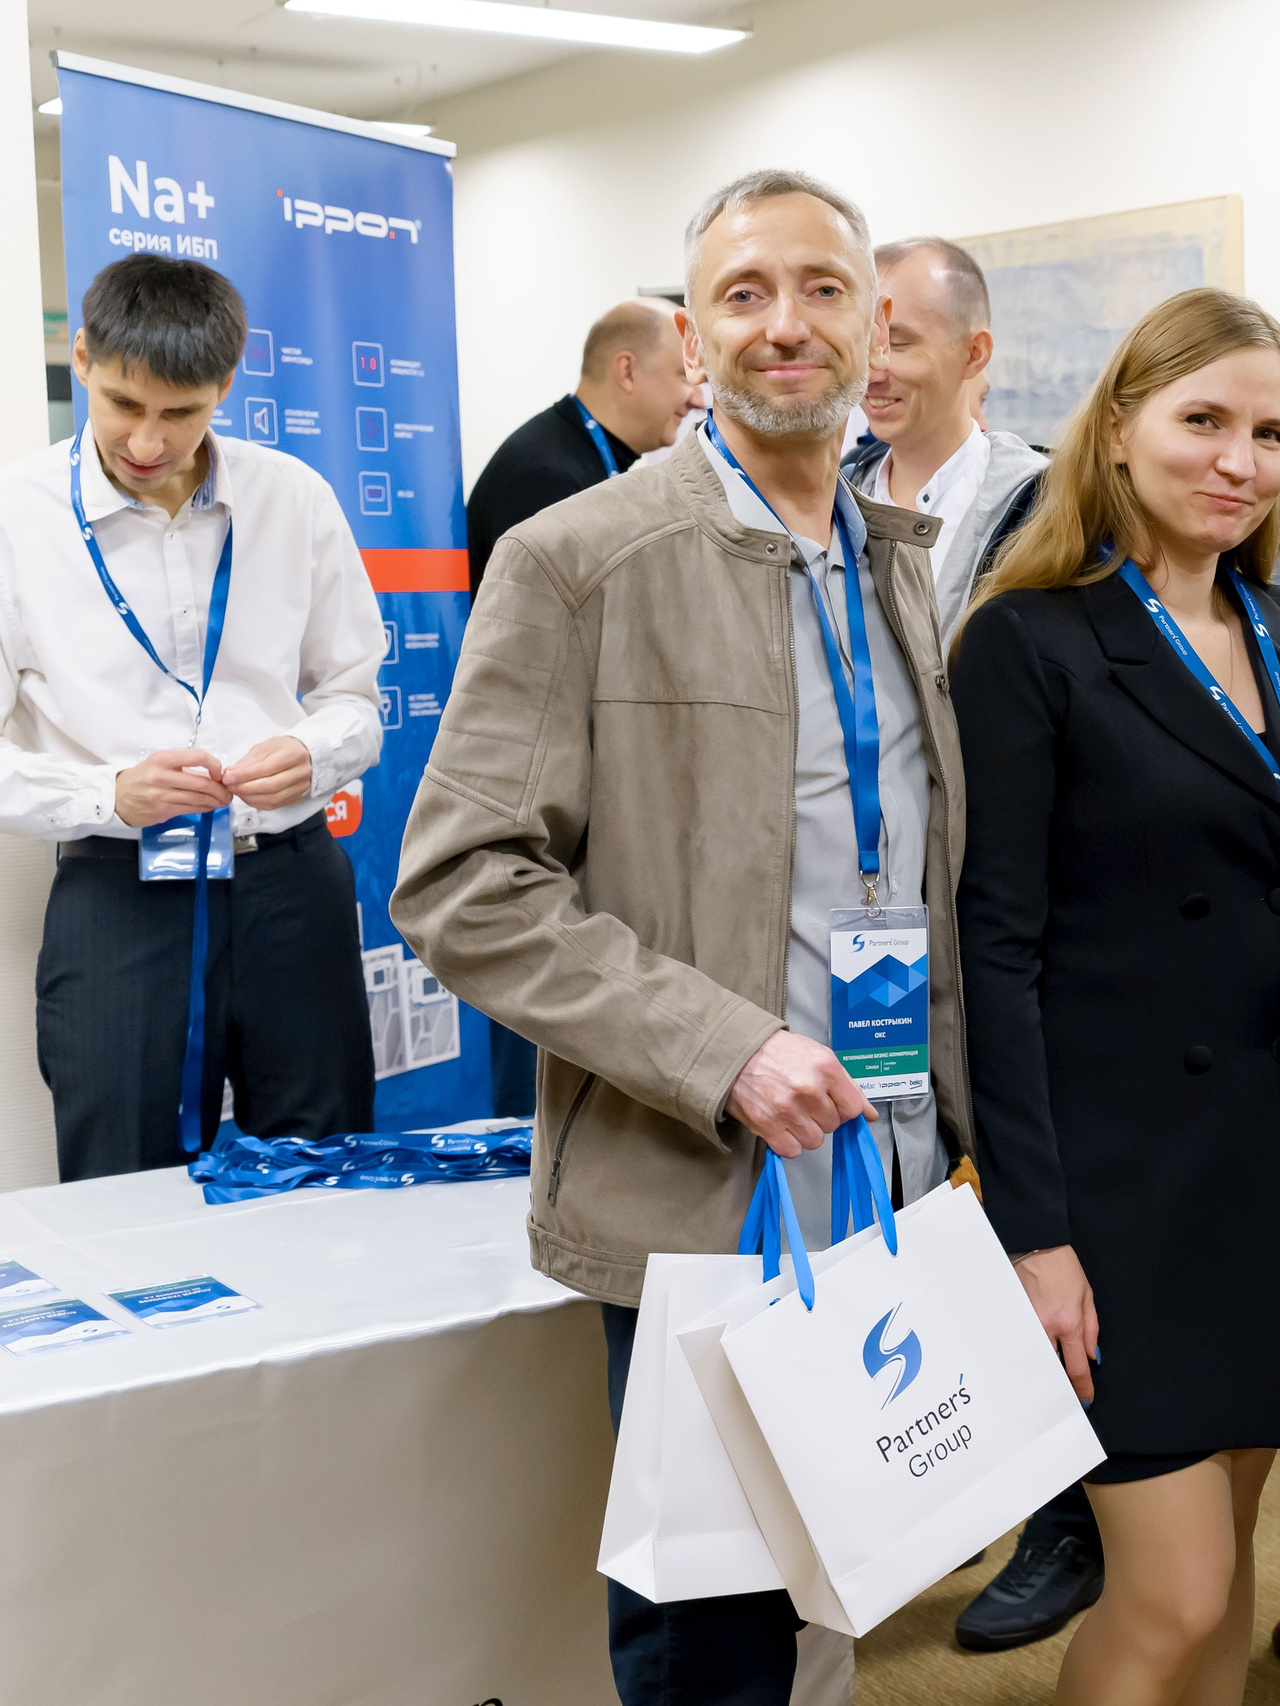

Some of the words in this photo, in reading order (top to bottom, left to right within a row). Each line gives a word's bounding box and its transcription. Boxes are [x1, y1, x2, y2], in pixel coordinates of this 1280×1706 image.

[107, 154, 216, 225] Na+
[108, 227, 172, 253] серия
[176, 233, 219, 260] ИБП
[848, 1020, 871, 1029] ПАВЕЛ
[908, 1424, 973, 1478] Group
